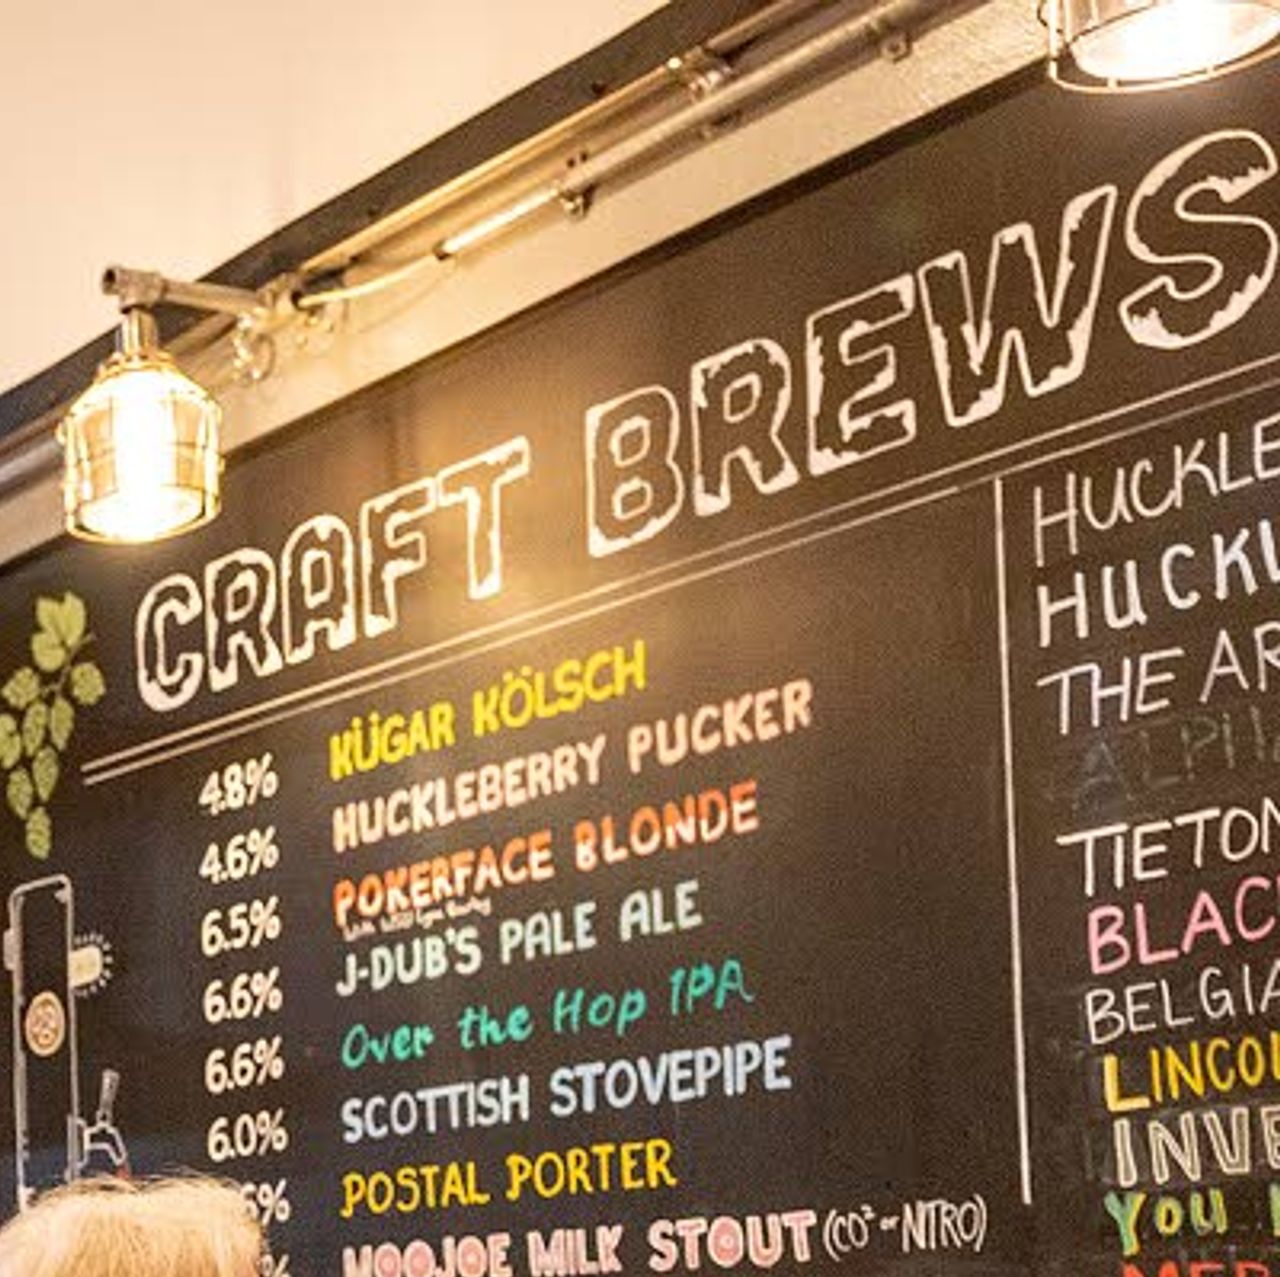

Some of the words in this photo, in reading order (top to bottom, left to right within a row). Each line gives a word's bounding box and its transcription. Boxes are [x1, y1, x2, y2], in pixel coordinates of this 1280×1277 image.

[136, 435, 531, 712] CRAFT
[584, 128, 1279, 558] BREWS
[198, 752, 279, 816] 4.8%
[329, 701, 456, 782] KÜGAR
[472, 638, 646, 737] KÖLSCH
[1036, 646, 1185, 736] THE
[198, 825, 280, 885] 4.6%
[332, 733, 607, 854] HUCKLEBERRY
[627, 678, 812, 774] PUCKER
[200, 895, 282, 957] 6.5%
[332, 828, 556, 929] POKERFACE
[573, 777, 760, 872] BLONDE
[1087, 875, 1280, 975] BLAC
[202, 967, 283, 1025] 6.6%
[335, 925, 483, 997] J-DUB'S
[498, 901, 597, 965] PALE
[619, 878, 703, 942] ALE
[204, 1034, 285, 1095] 6.6%
[341, 1023, 435, 1069] Over
[457, 1003, 533, 1050] the
[552, 986, 647, 1037] Hop
[669, 959, 756, 1016] IPA
[206, 1107, 289, 1163] 6.0%
[341, 1073, 530, 1144] SCOTTISH
[548, 1033, 793, 1118] STOVEPIPE
[341, 1161, 490, 1218] POSTAL
[505, 1138, 678, 1201] PORTER
[647, 1208, 818, 1272] STOUT
